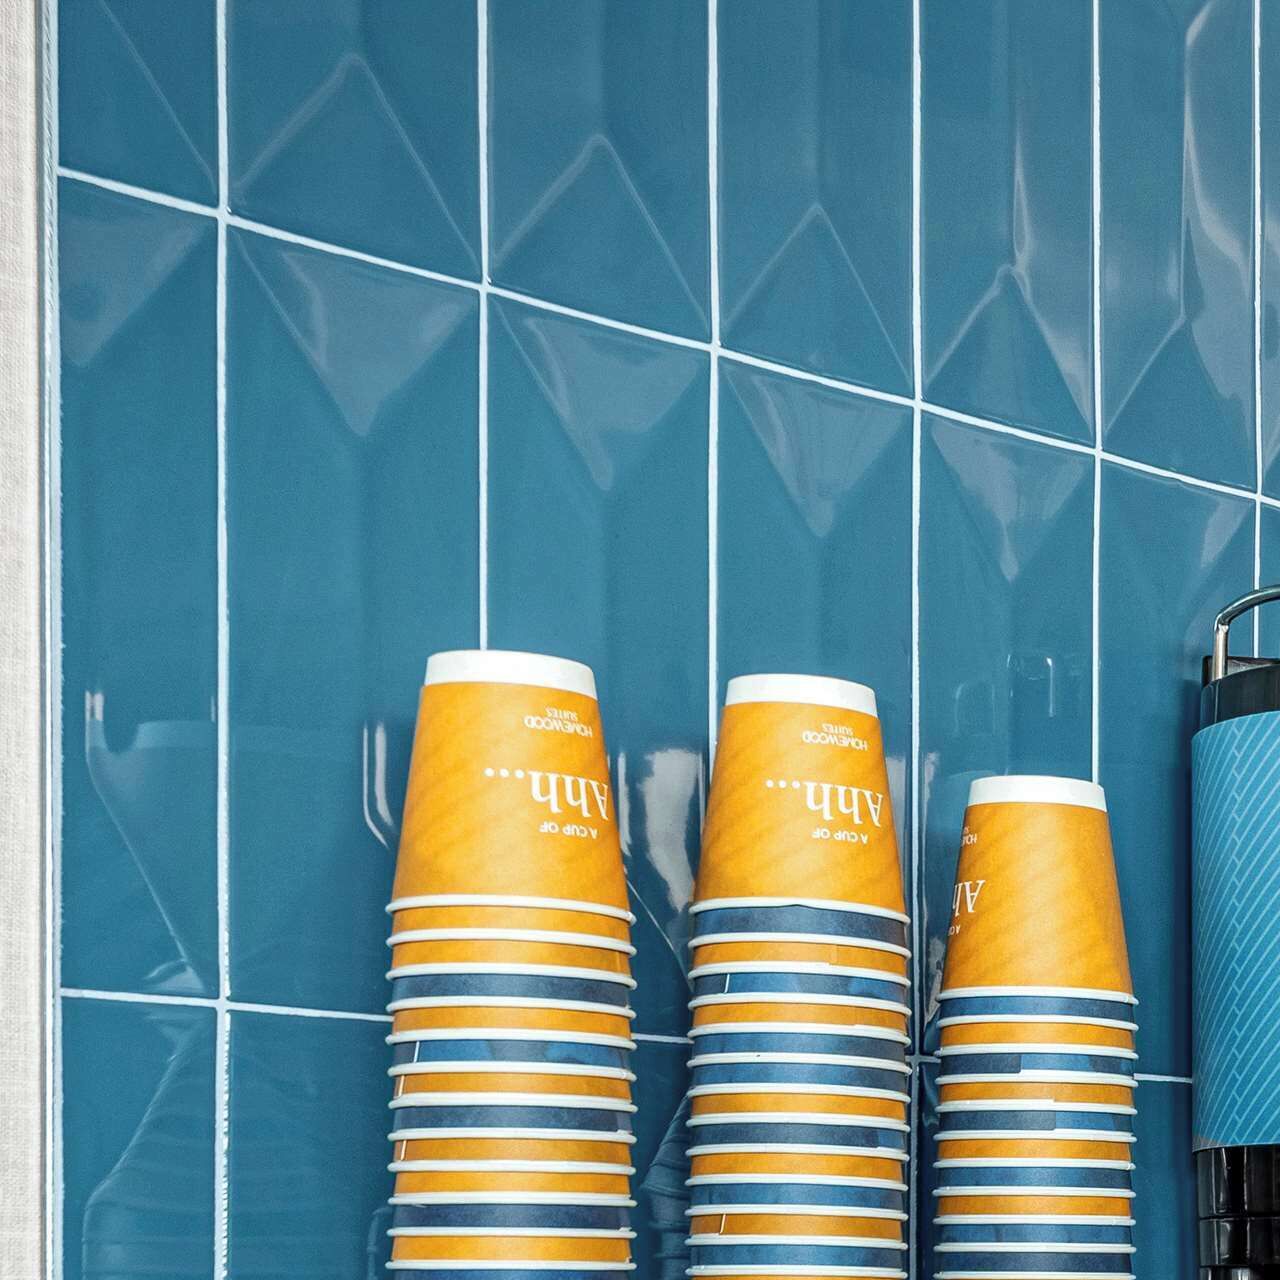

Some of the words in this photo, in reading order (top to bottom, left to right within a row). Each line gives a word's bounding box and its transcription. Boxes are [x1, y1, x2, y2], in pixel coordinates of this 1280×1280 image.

[545, 706, 578, 721] SUITES
[523, 715, 593, 737] HOMEWOOD
[822, 723, 854, 736] SUITES
[802, 730, 868, 751] HOMEWOOD
[539, 821, 559, 833] OF
[562, 824, 589, 838] CUP
[588, 827, 598, 839] A
[812, 827, 830, 839] OF
[833, 831, 858, 843] CUP
[860, 833, 868, 844] A
